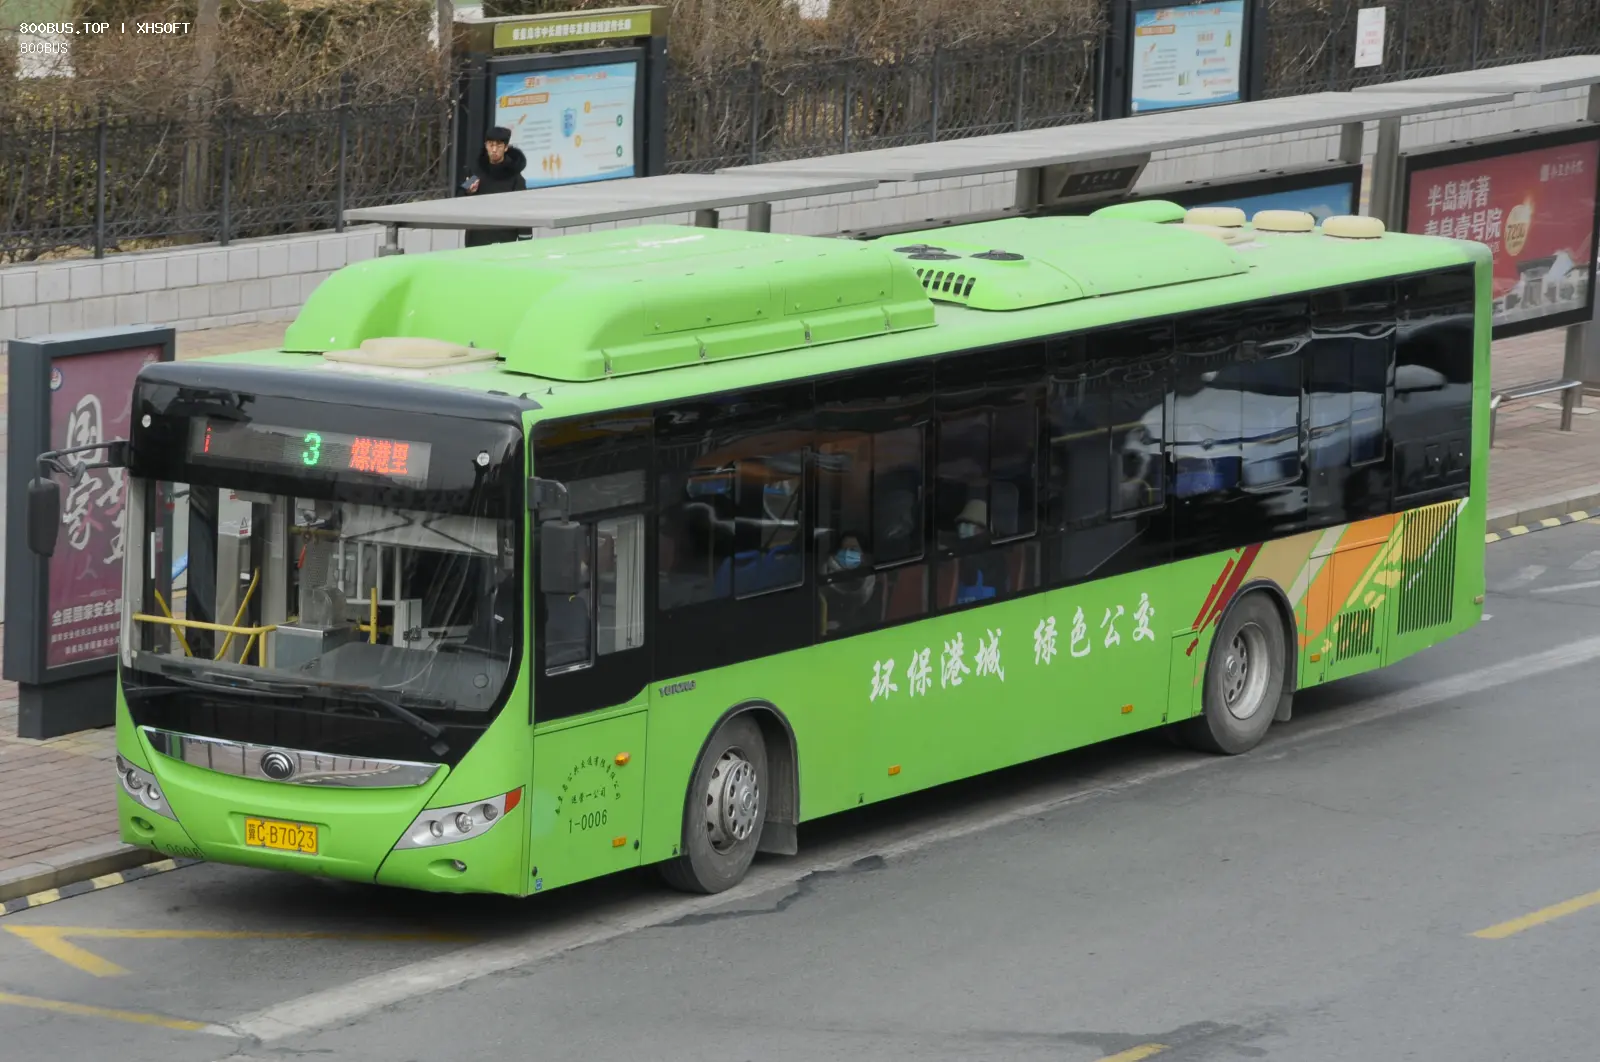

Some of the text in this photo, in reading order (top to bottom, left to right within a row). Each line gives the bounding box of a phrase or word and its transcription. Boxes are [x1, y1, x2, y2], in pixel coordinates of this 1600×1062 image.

[1426, 176, 1491, 216] 半岛新著
[302, 432, 322, 466] 3
[869, 592, 1155, 702] 环保港城 绿色公交
[568, 808, 608, 834] 1-0006
